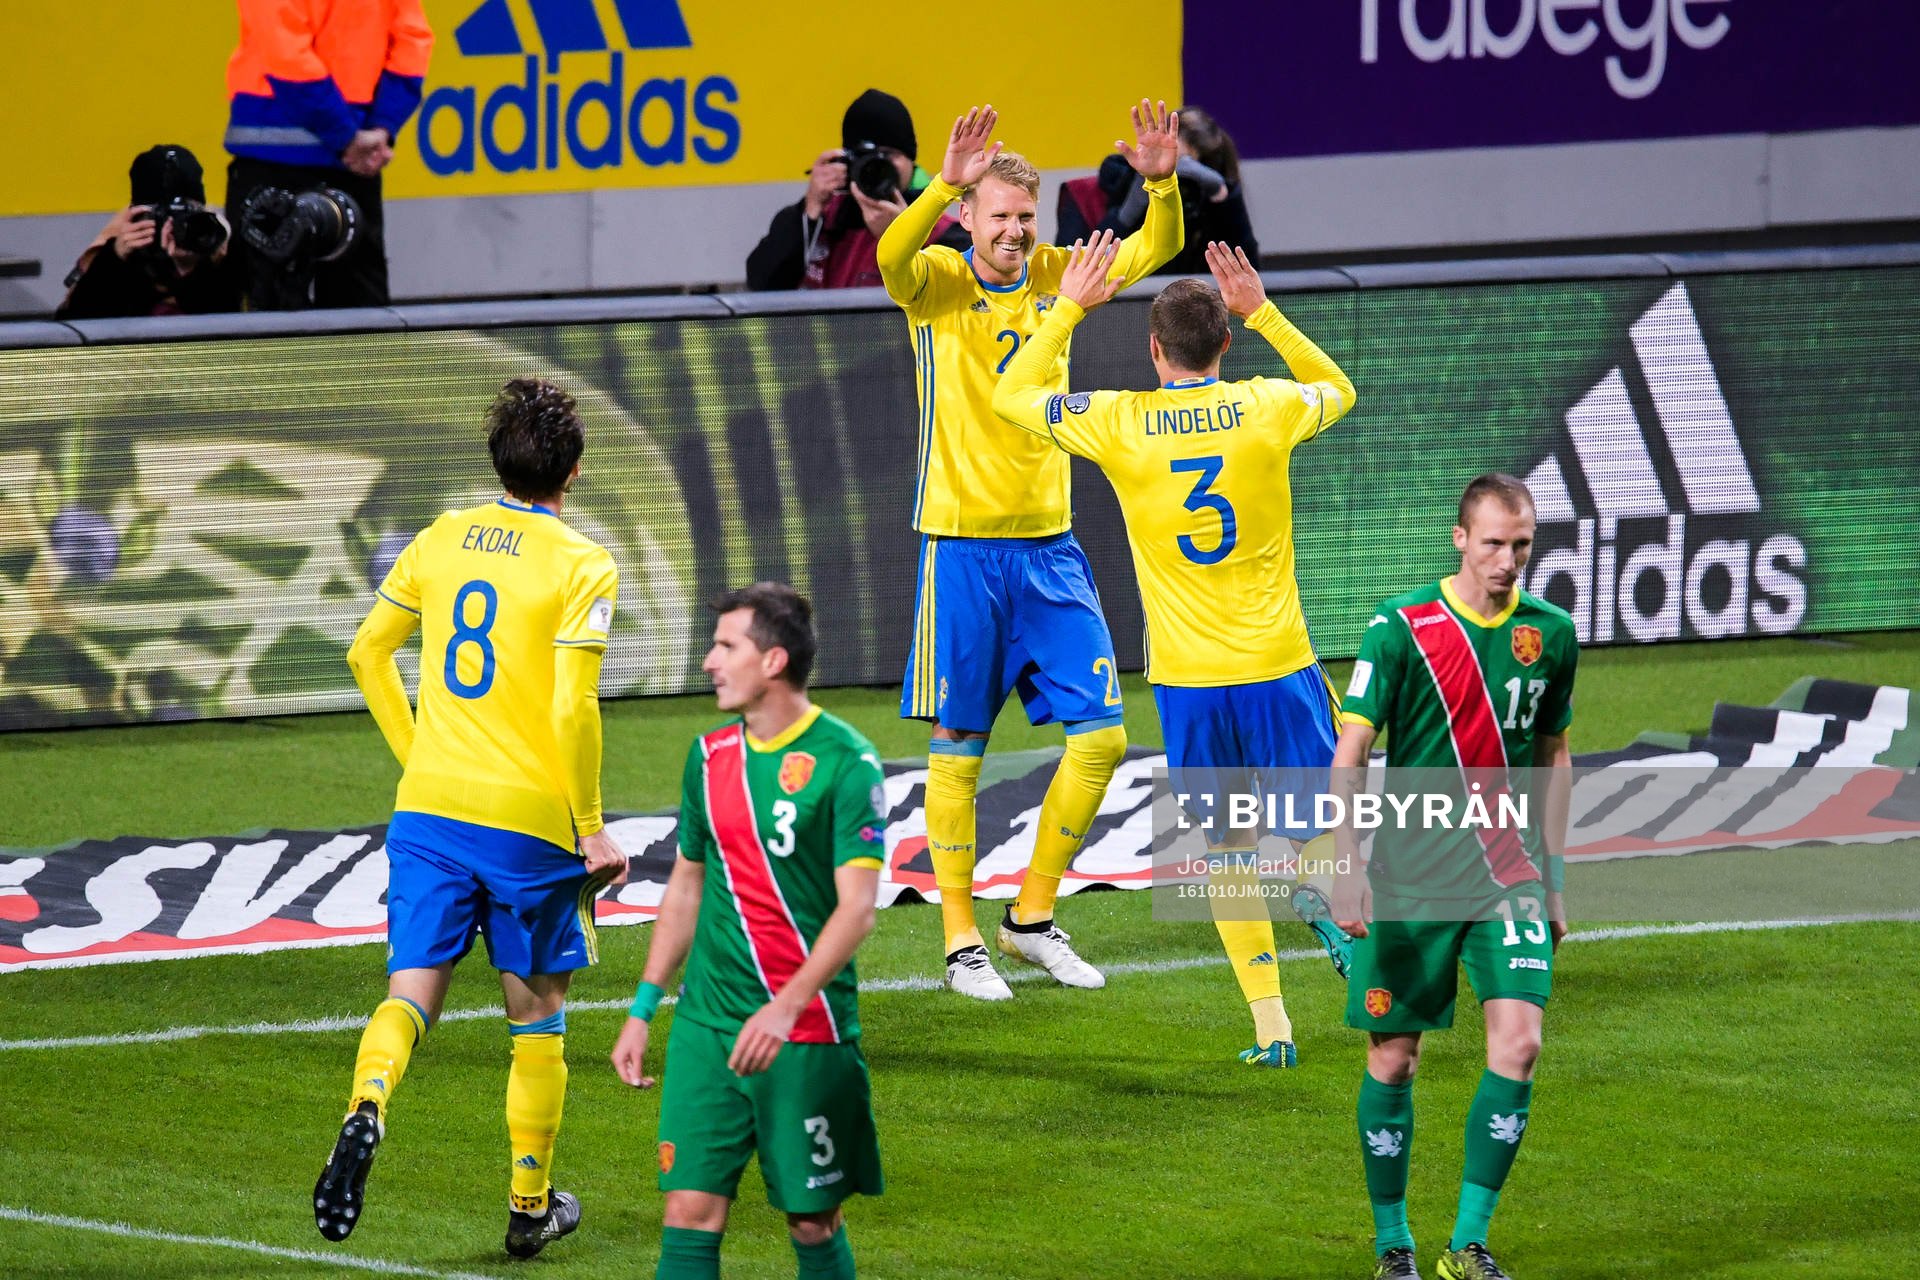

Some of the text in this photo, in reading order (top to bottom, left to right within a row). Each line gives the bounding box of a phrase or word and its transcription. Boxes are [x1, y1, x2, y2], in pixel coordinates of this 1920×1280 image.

[416, 52, 742, 177] adidas
[1145, 399, 1245, 436] LINDELÖF
[1170, 455, 1238, 565] 3
[462, 524, 524, 557] EKDAL
[1515, 513, 1807, 642] didas
[443, 579, 498, 700] 8
[1504, 676, 1547, 730] 13
[767, 799, 798, 858] 3
[1494, 896, 1547, 947] 13
[803, 1115, 836, 1168] 3
